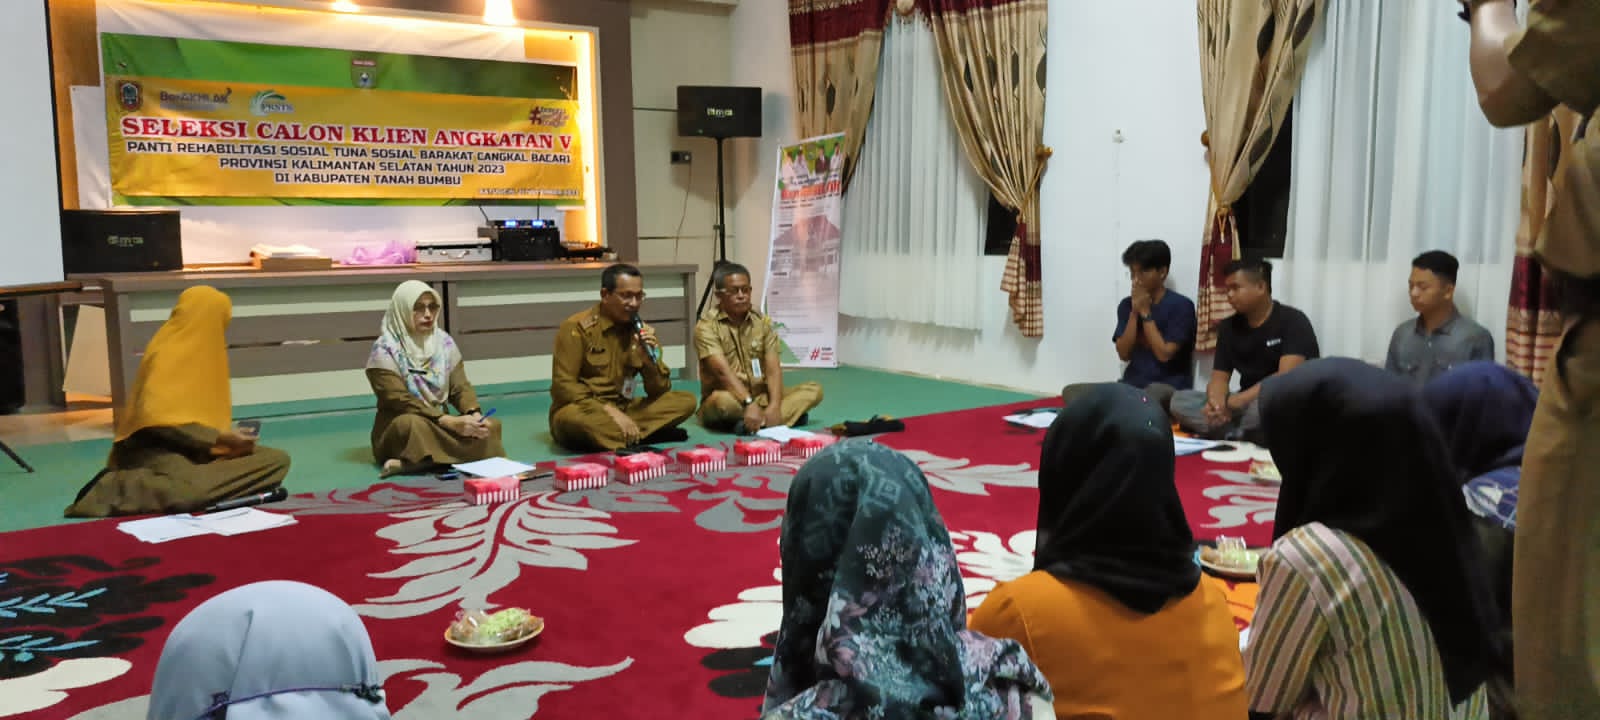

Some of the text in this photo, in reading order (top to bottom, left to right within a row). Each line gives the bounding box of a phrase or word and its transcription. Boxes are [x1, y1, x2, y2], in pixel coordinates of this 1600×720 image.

[122, 118, 572, 150] SELEKSI CALON KLIEN ANGKATAN V
[128, 141, 570, 163] PANTI REHABILITASI SOSIAL TUNA SOSIAL BARAKAT CANGKAL BACARI
[220, 158, 505, 174] PROVINSI KALIMANTAN SELATAN TAHUN 2023
[275, 173, 461, 185] DI KABUPATEN TANAH BUMBU
